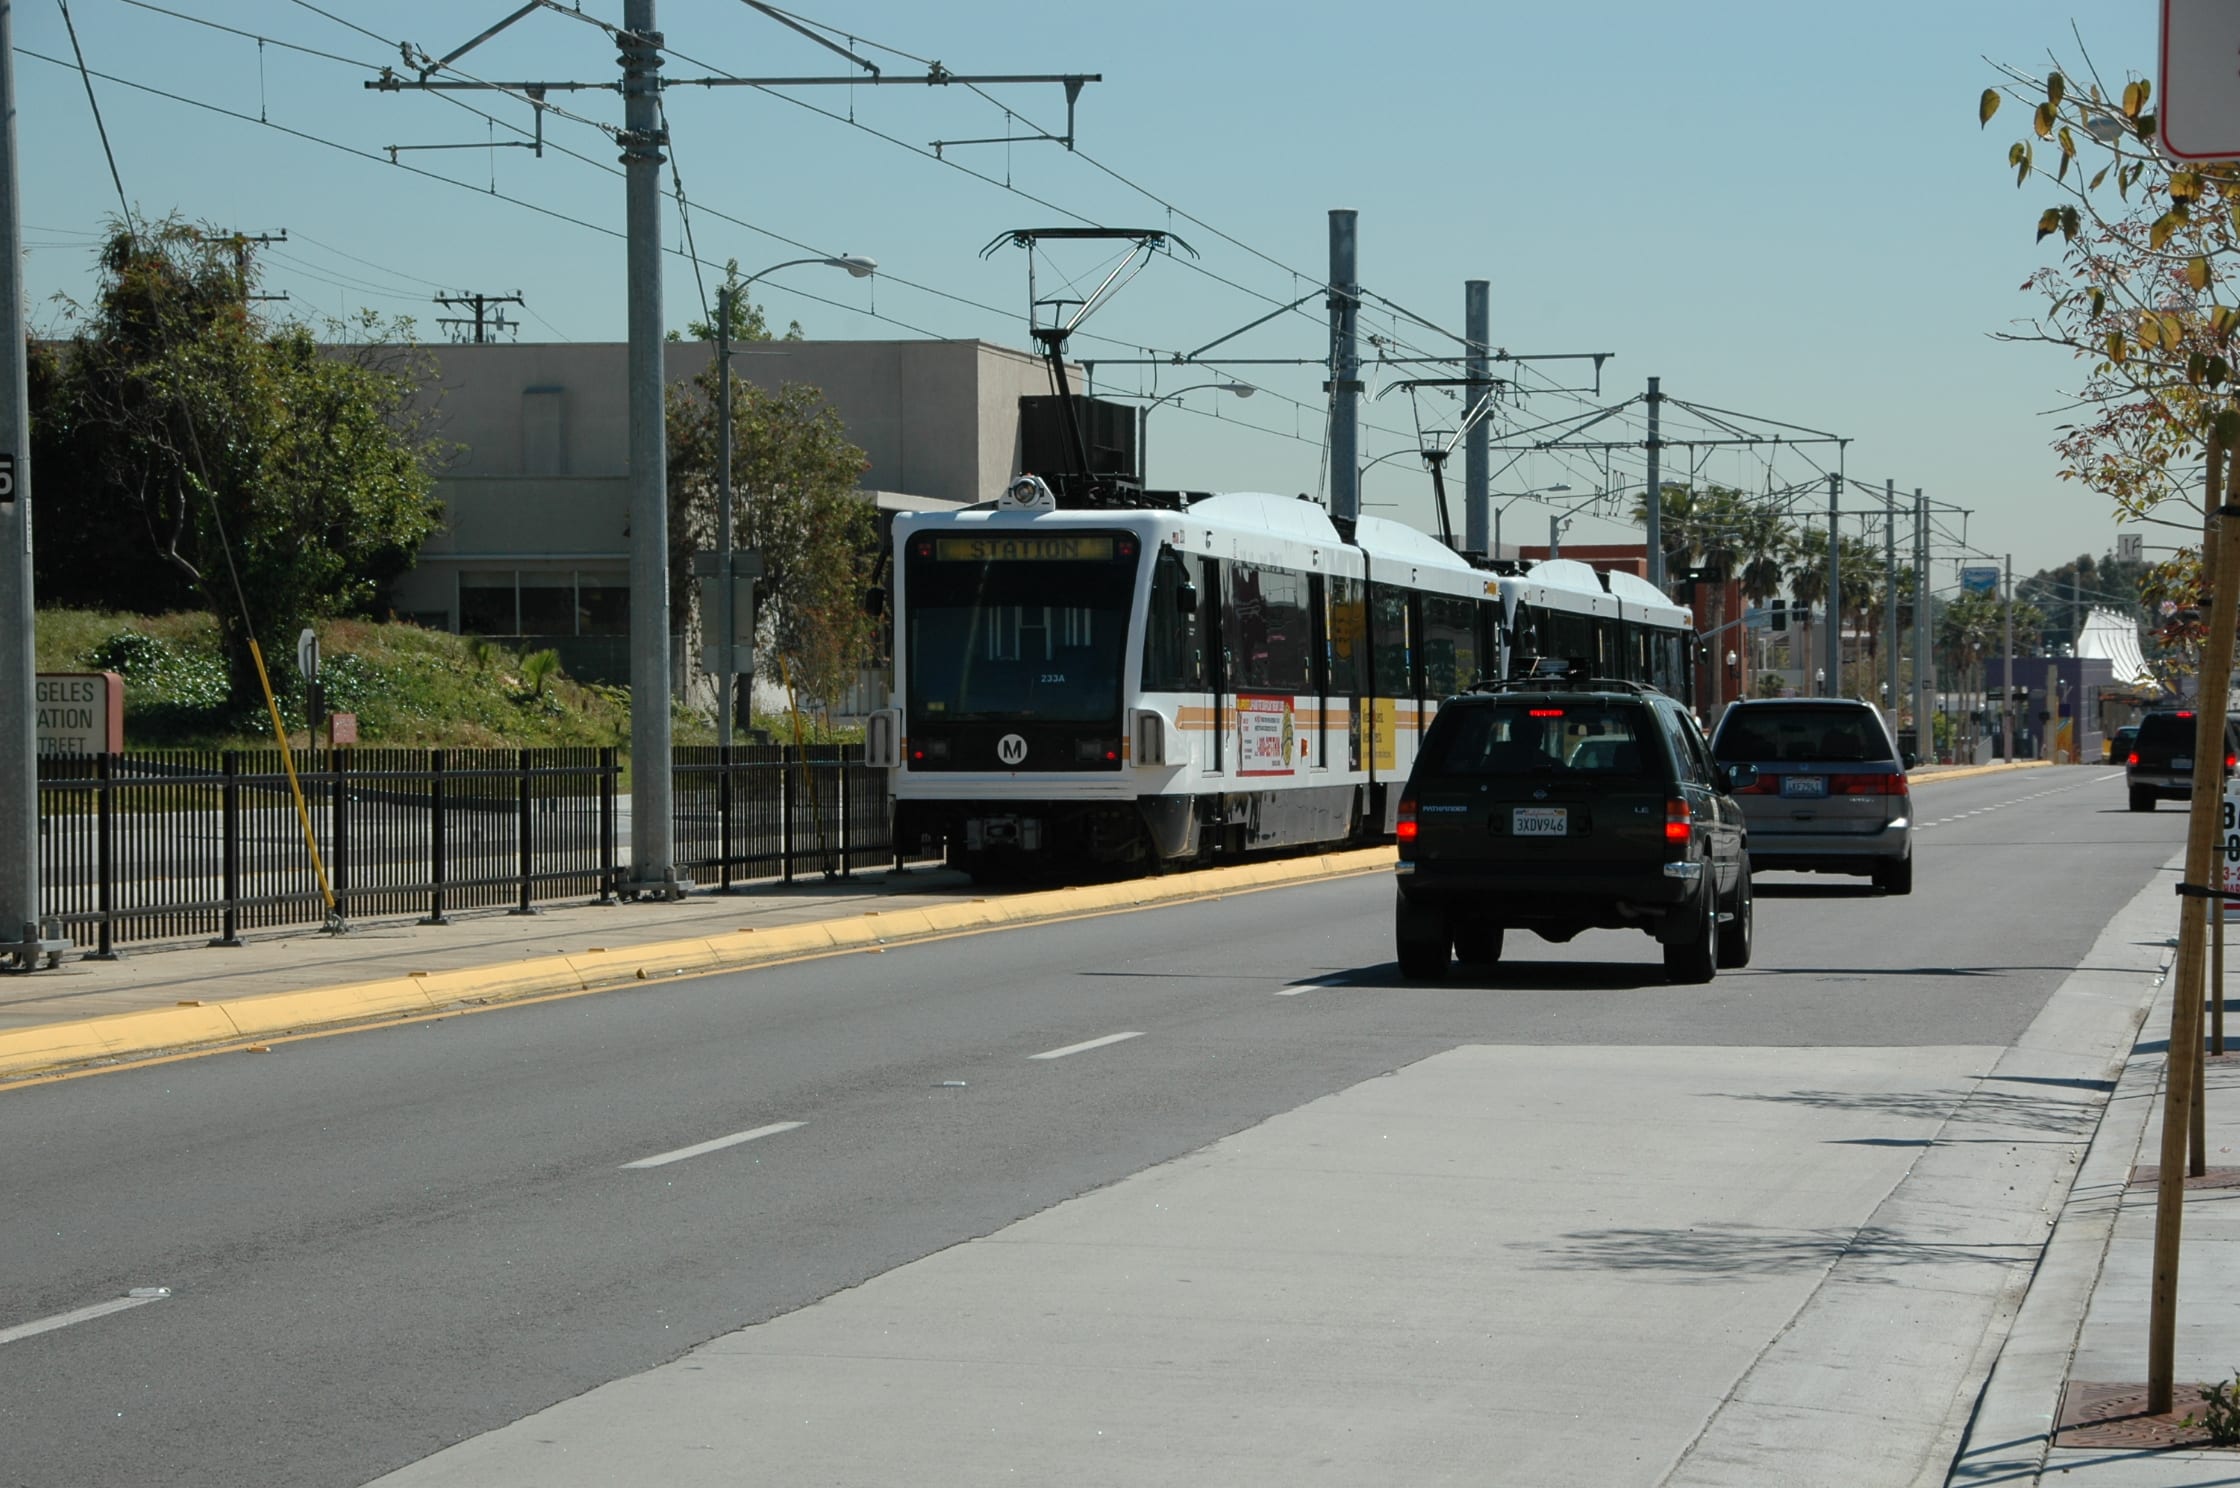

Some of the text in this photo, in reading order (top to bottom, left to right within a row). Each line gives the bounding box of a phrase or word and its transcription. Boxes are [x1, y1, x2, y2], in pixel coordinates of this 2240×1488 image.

[971, 539, 1079, 560] STATION
[1041, 674, 1065, 683] 233A
[36, 708, 93, 729] ATION
[1003, 740, 1022, 759] M
[1517, 818, 1564, 831] 3XDV946
